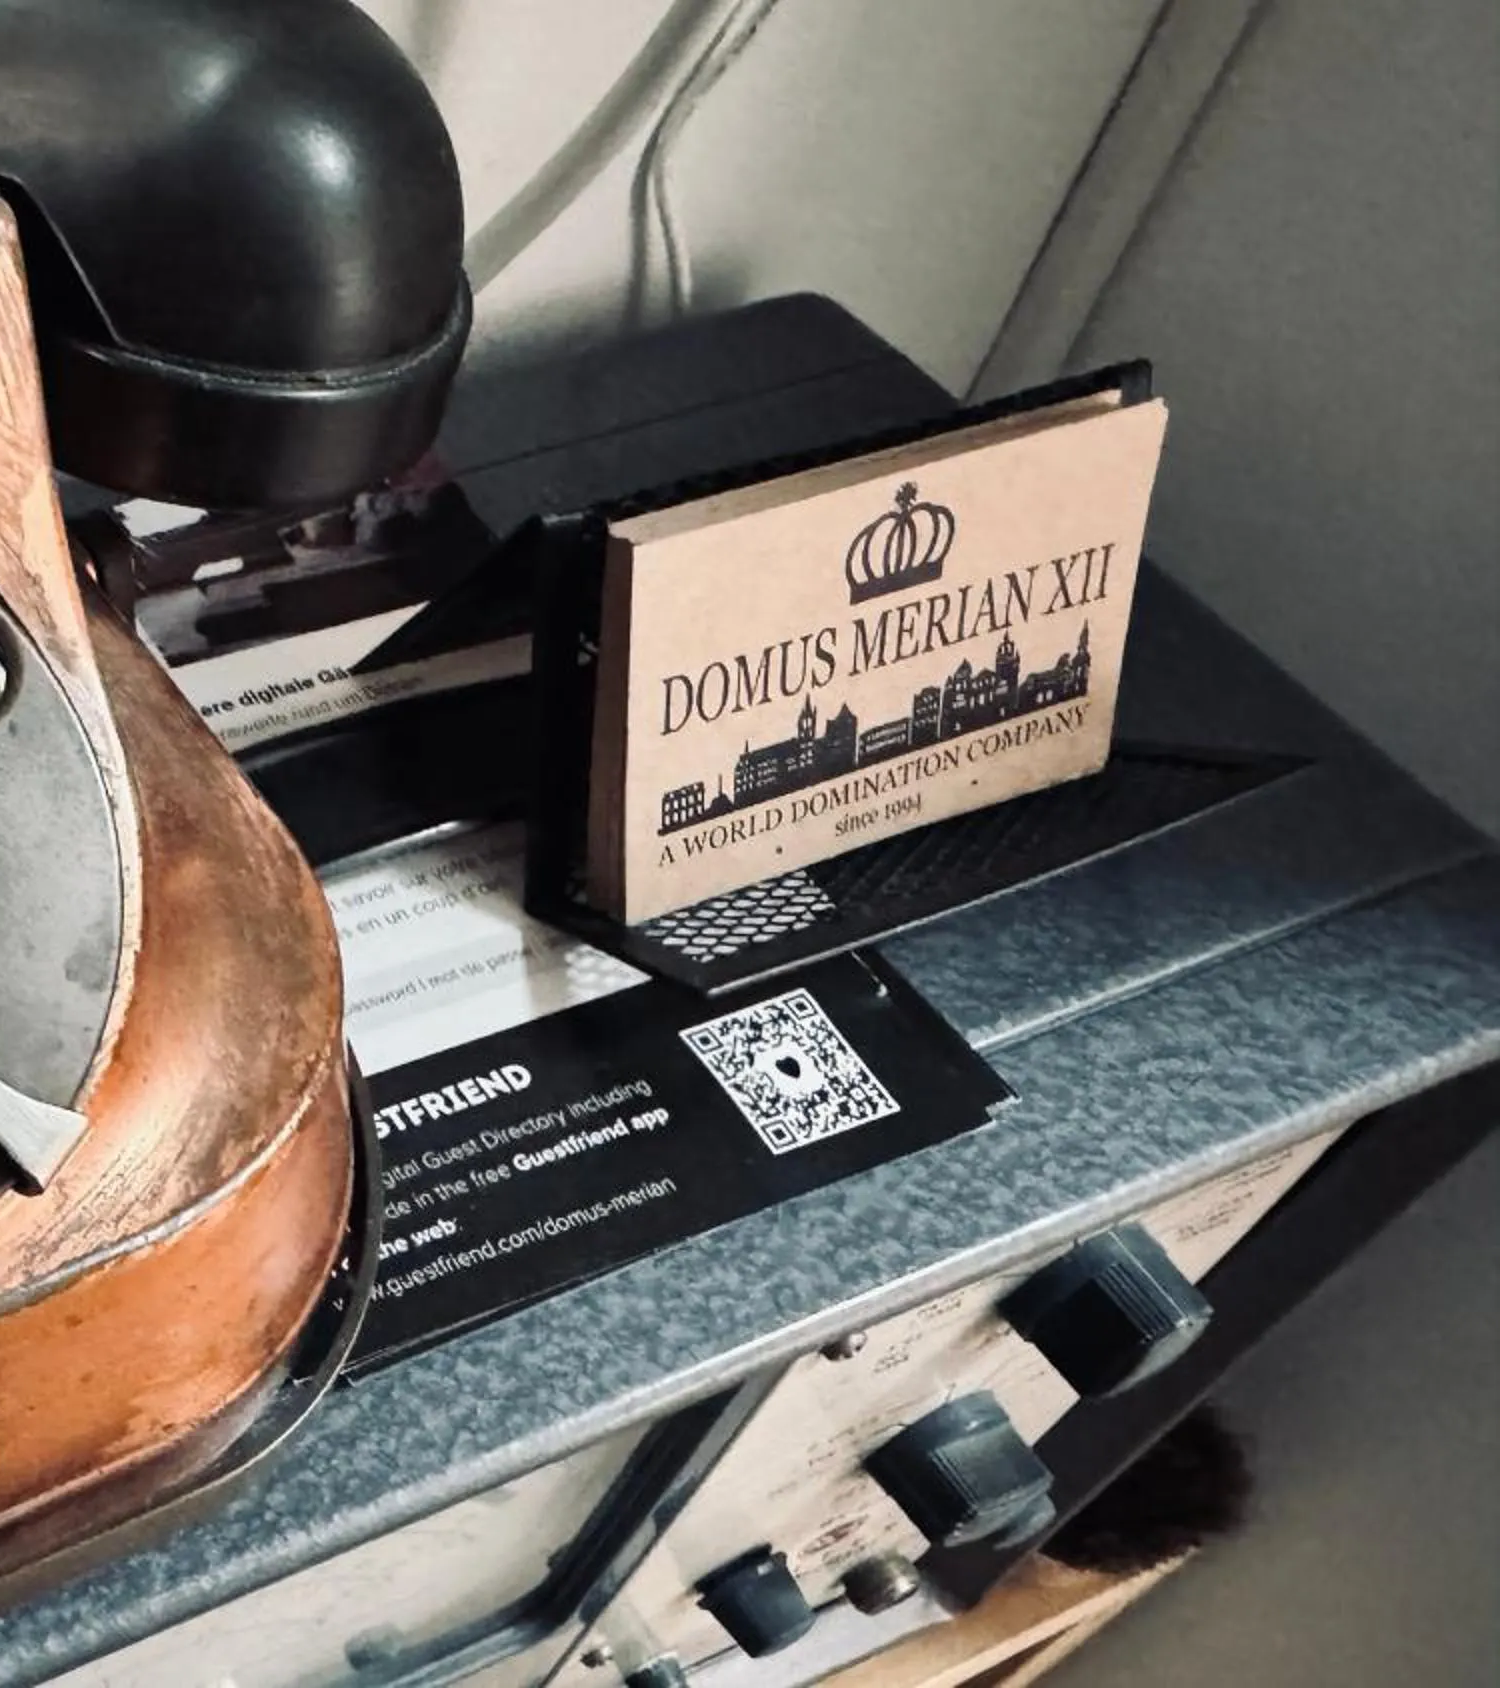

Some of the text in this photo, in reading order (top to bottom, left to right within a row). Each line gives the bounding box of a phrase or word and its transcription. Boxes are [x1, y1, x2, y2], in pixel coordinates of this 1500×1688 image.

[659, 542, 1116, 737] DOMUS MERIAN XII
[238, 675, 316, 707] digitale
[658, 701, 1092, 868] A WORLD DOMINATION COMPANY
[835, 793, 923, 838] since 1994
[373, 1063, 533, 1140] STFRIEND
[421, 1138, 483, 1170] Guest
[478, 1108, 567, 1151] Directory
[565, 1079, 654, 1119] including
[384, 1106, 670, 1220] de in the free Guestfriend app
